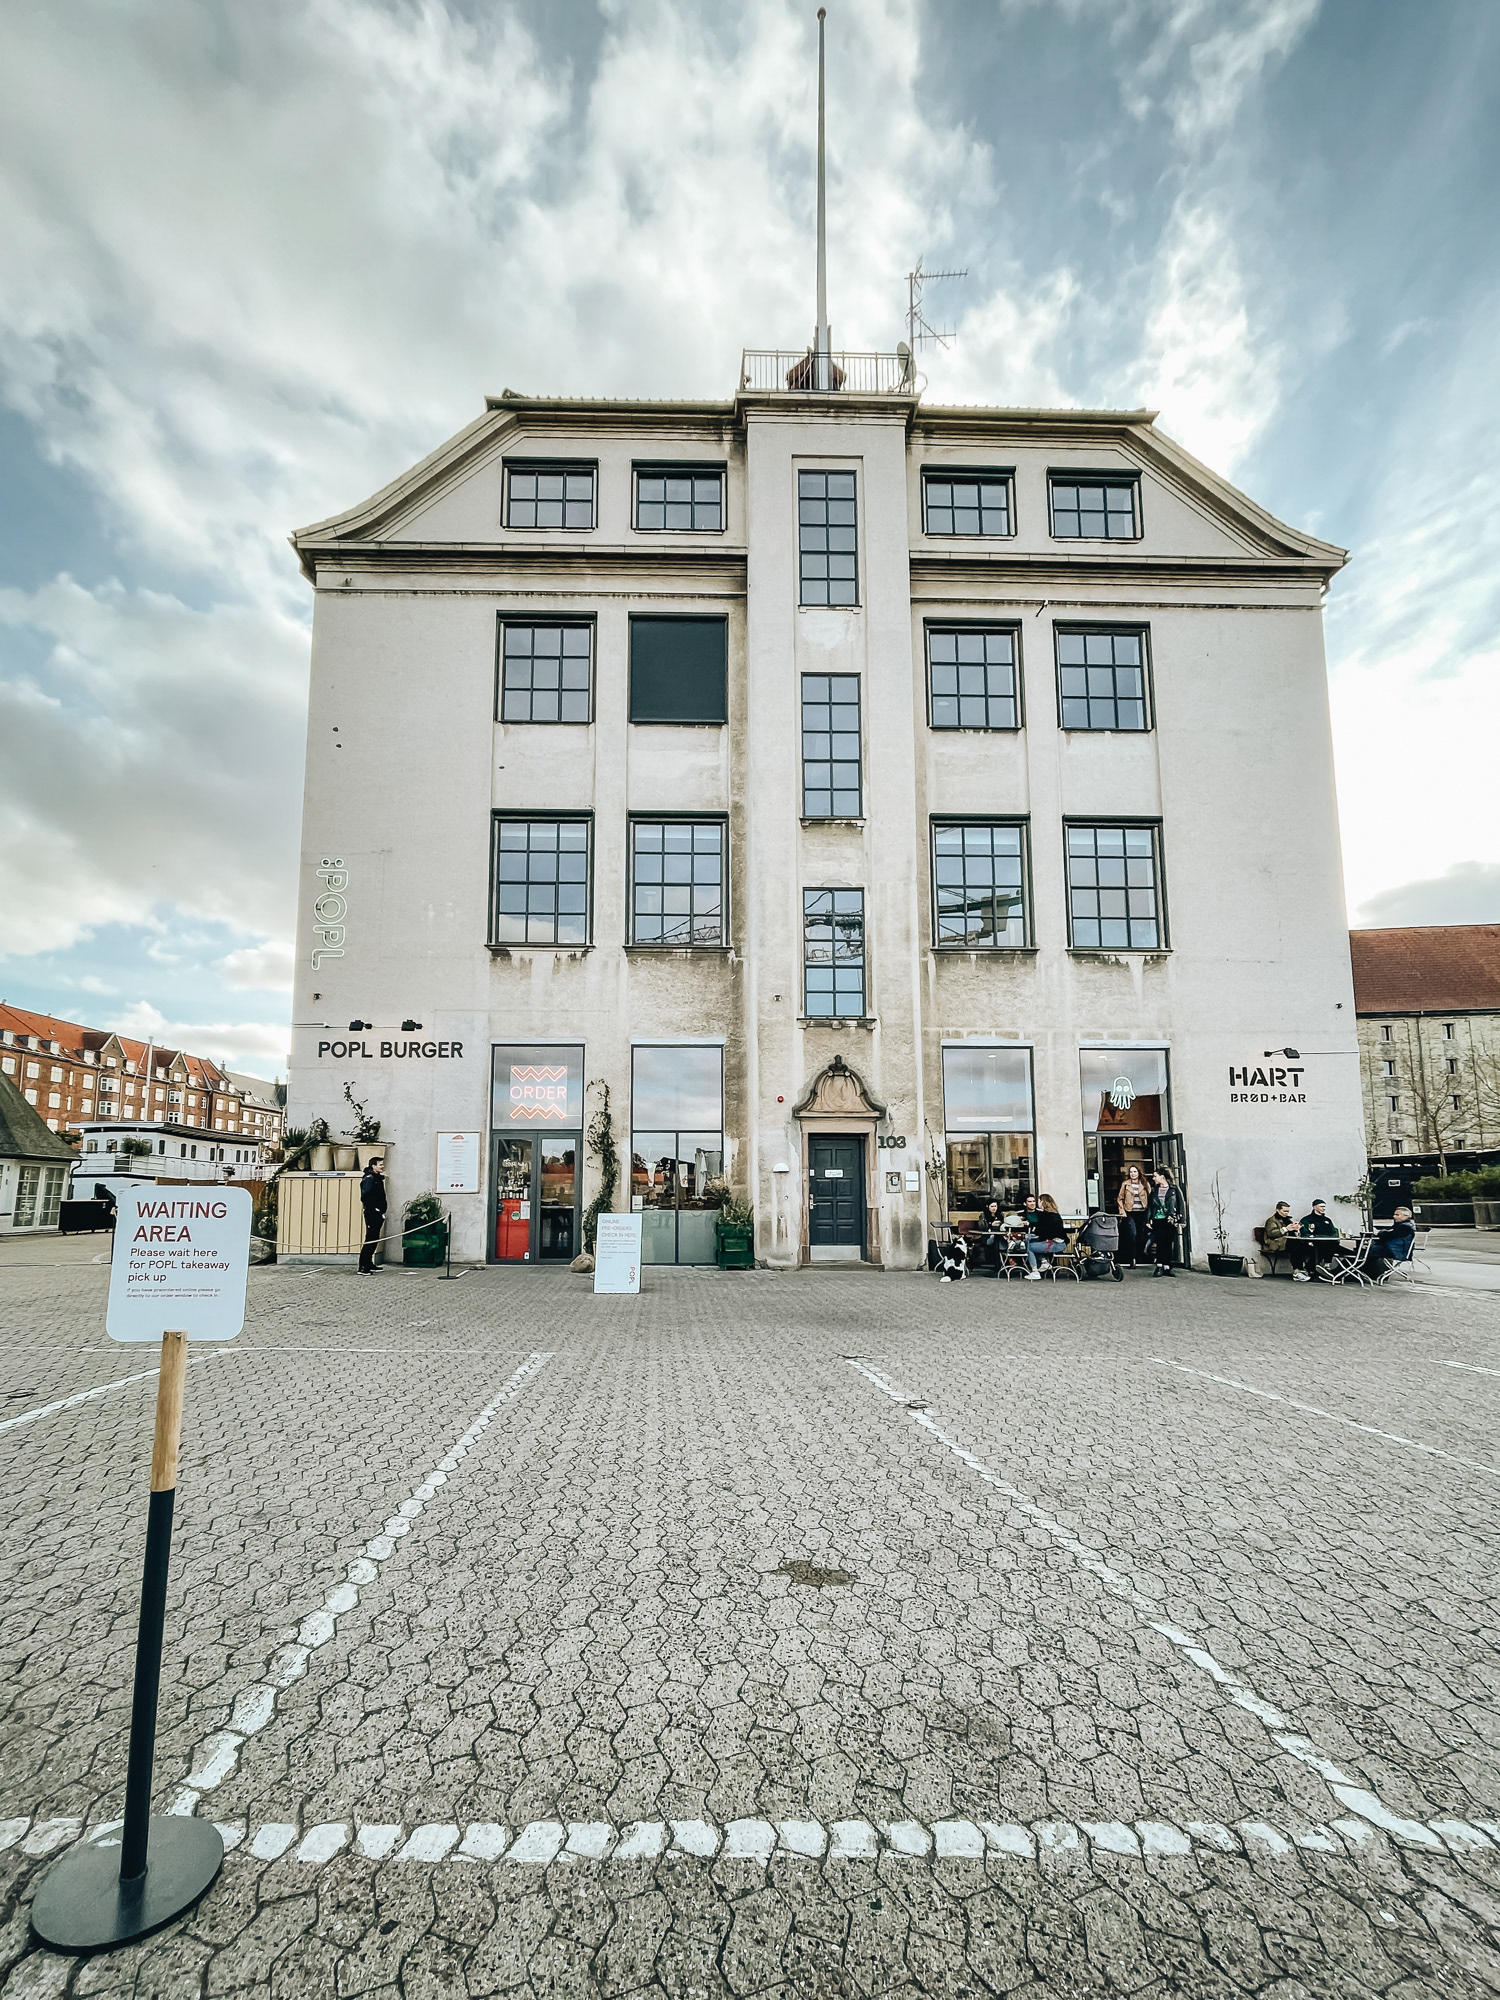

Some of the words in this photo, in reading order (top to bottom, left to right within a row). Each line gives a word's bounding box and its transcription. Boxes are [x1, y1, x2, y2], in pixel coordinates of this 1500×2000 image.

[318, 1041, 373, 1058] POPL
[380, 1041, 463, 1058] BURGER
[1229, 1066, 1305, 1087] HART
[509, 1085, 567, 1100] ORDER
[877, 1135, 907, 1149] 103
[136, 1201, 227, 1219] WAITING
[133, 1225, 192, 1242] AREA
[130, 1248, 165, 1257] Please
[168, 1248, 190, 1257] wait
[193, 1248, 218, 1257] here
[129, 1260, 145, 1269] for
[148, 1260, 178, 1269] POPL
[181, 1260, 230, 1271] takeaway
[127, 1273, 150, 1283] pick
[153, 1274, 167, 1283] up
